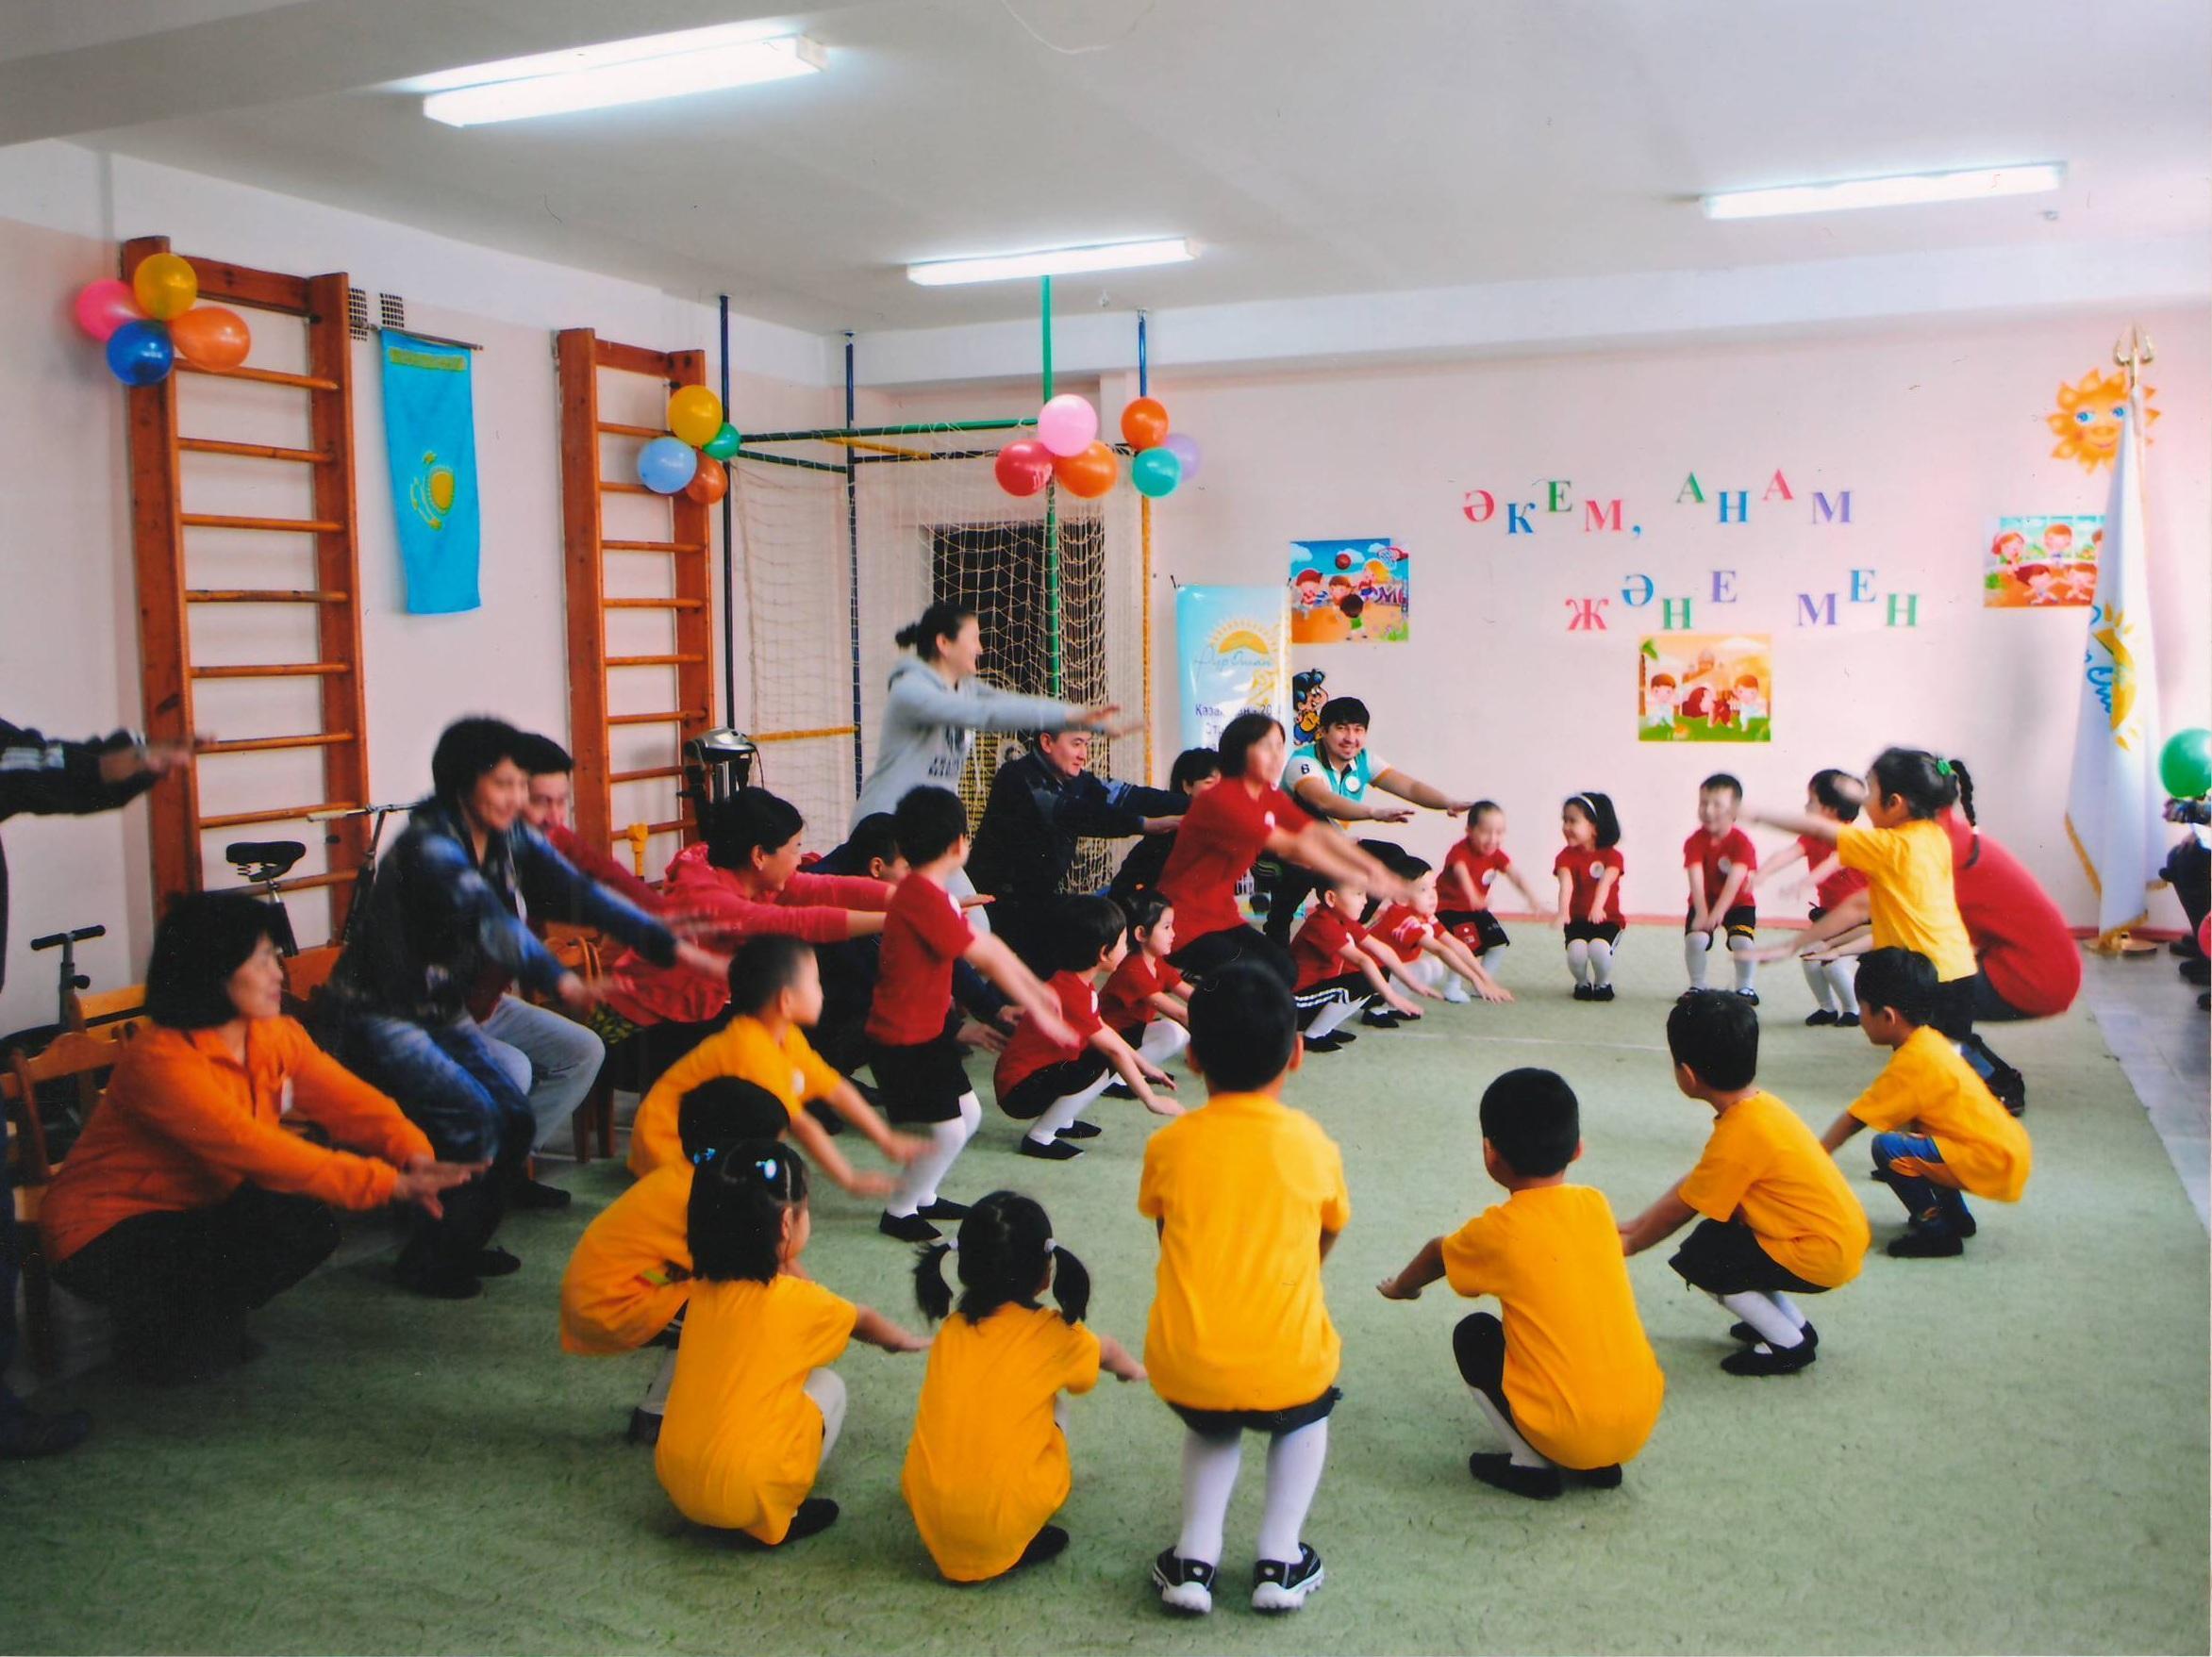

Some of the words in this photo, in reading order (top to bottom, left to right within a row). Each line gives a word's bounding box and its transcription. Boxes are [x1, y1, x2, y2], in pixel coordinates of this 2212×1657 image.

[1463, 479, 1641, 539] ӘКЕМ,
[1675, 470, 1852, 523] АНАМ
[1565, 570, 1737, 630] ЖӘНЕ
[1797, 569, 1920, 627] МЕН
